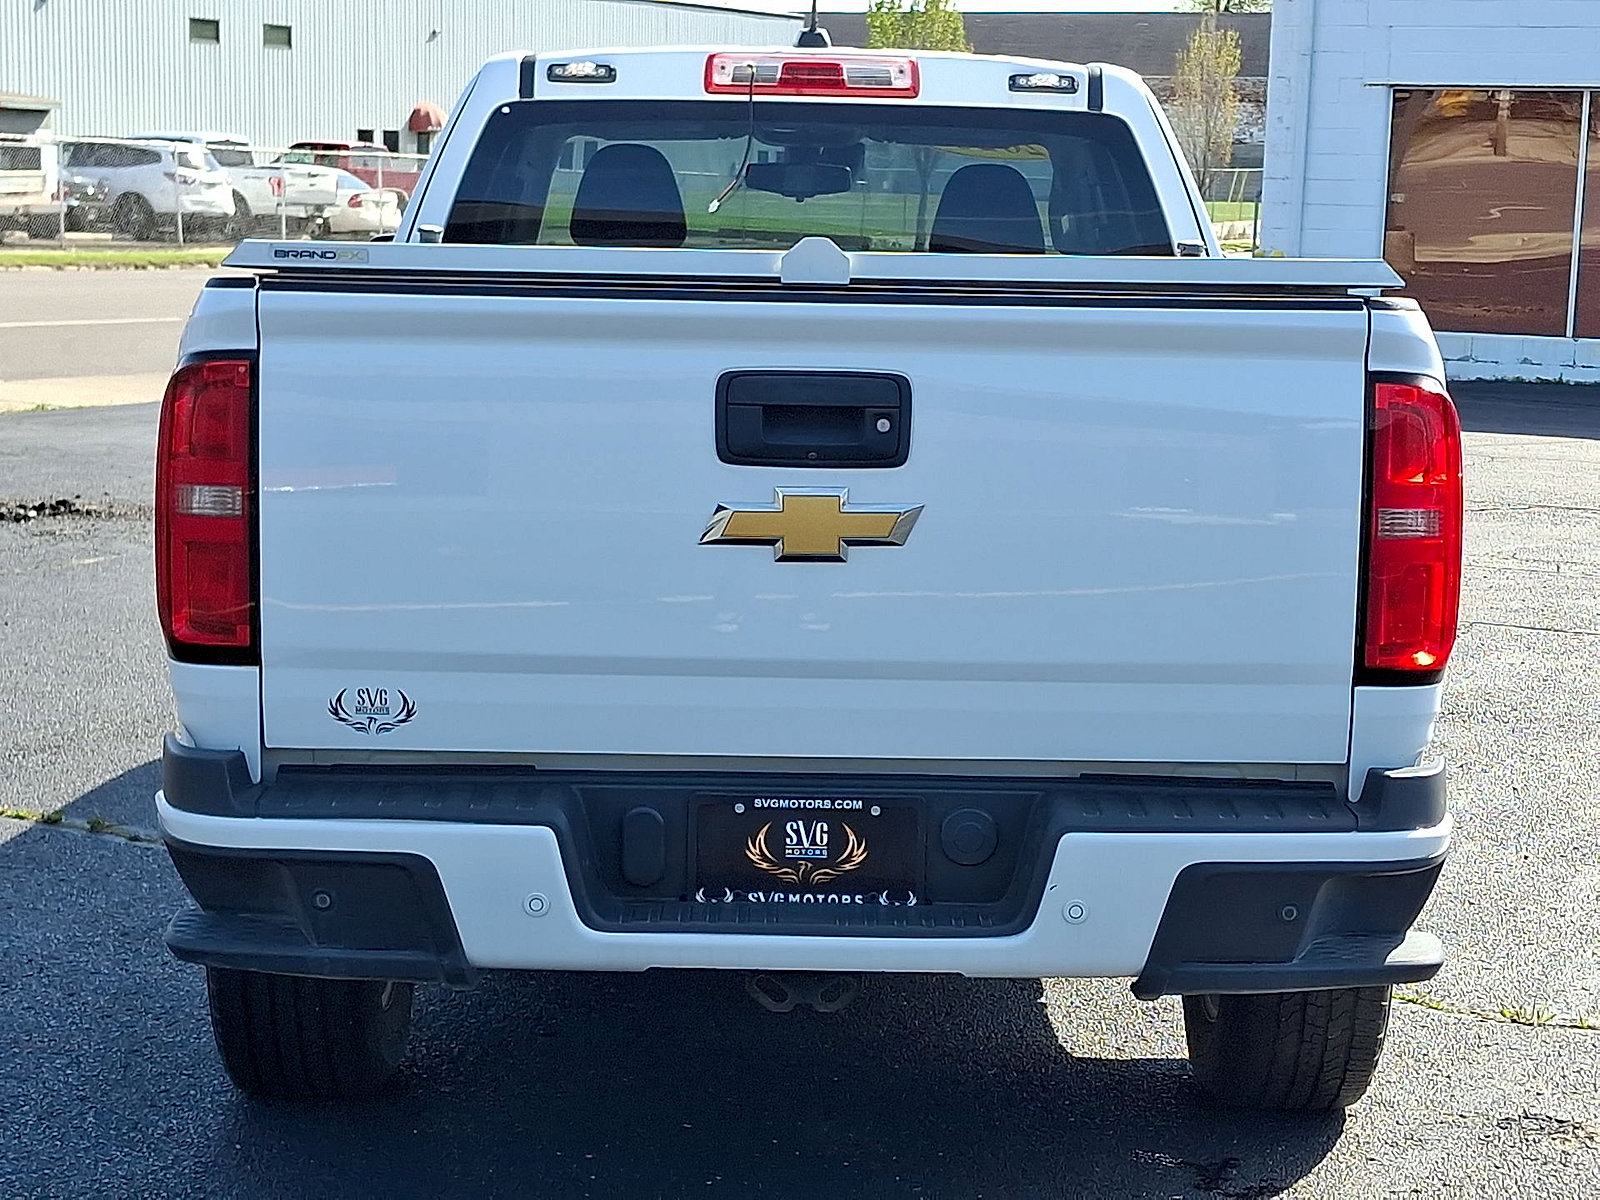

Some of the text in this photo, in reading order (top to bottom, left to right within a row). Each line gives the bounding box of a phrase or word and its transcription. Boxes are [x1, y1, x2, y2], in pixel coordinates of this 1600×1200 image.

[357, 687, 388, 707] SVG
[754, 798, 863, 809] SVGMOTORS.COM
[785, 820, 828, 848] SVG
